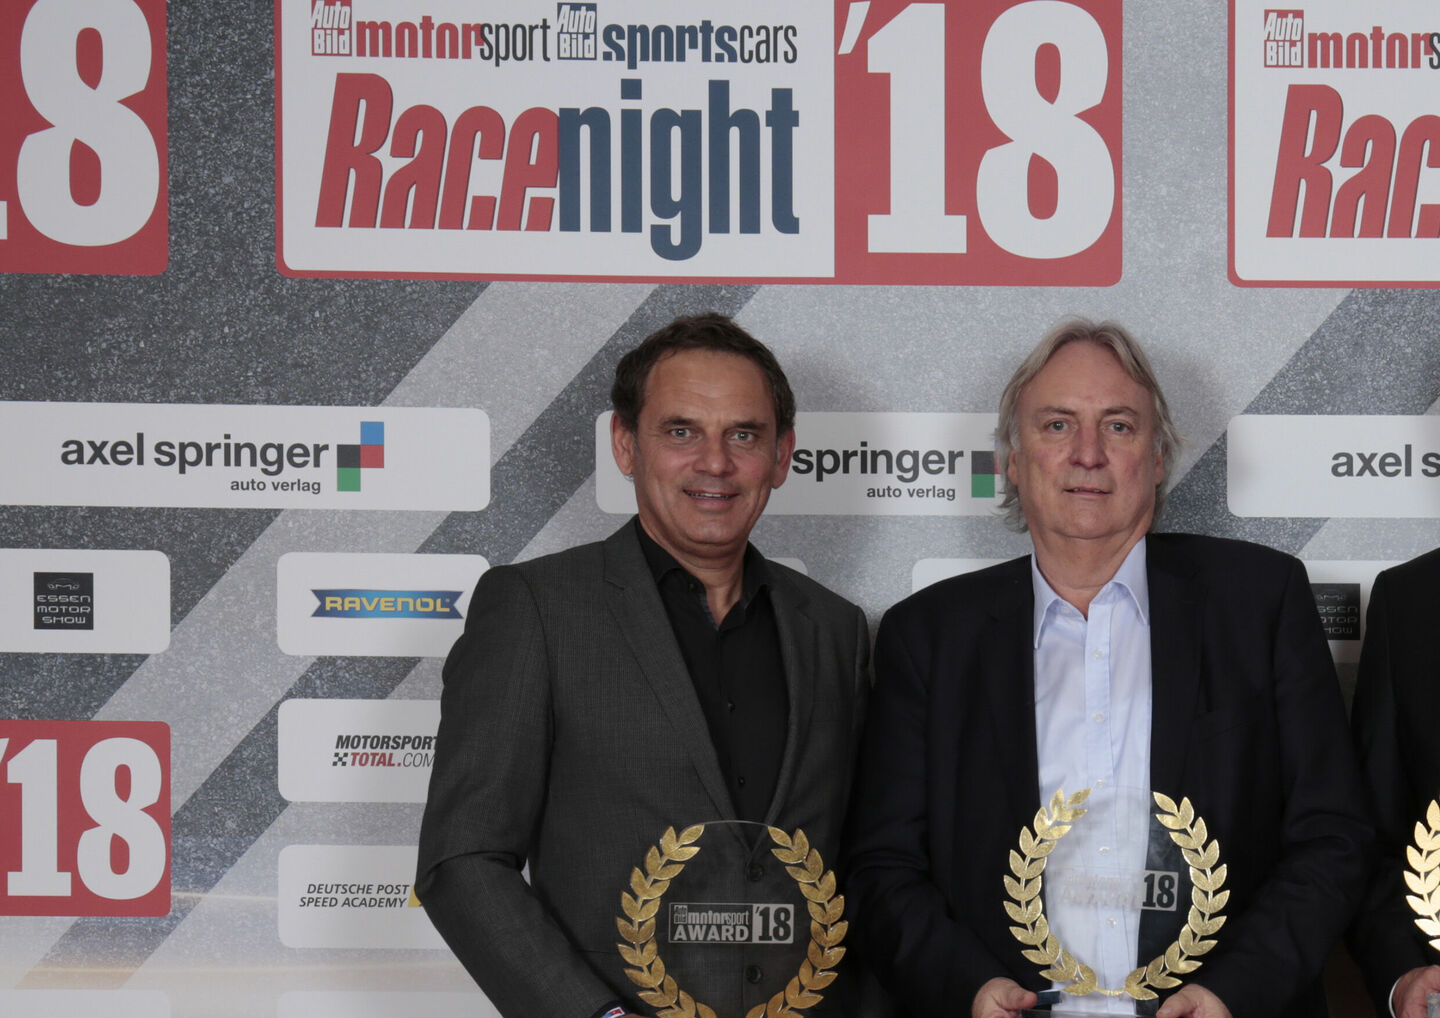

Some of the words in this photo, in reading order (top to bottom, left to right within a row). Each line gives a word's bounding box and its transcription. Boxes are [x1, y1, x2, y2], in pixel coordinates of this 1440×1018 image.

[311, 1, 351, 28] Auto
[557, 4, 596, 33] Auto
[1263, 12, 1303, 40] Auto
[313, 29, 349, 56] Bild
[356, 16, 551, 67] motorsport
[560, 33, 596, 60] Bild
[602, 19, 798, 70] sportscars
[1265, 40, 1302, 66] Bild
[0, 0, 160, 246] 8
[315, 72, 800, 261] Racenight
[60, 432, 144, 466] axel
[154, 433, 329, 476] springer
[792, 441, 964, 483] springer
[1331, 444, 1411, 478] axel
[230, 479, 267, 492] auto
[271, 478, 321, 495] verlag
[866, 485, 902, 498] auto
[907, 485, 957, 501] verlag
[325, 596, 451, 612] RAVENOL
[1317, 604, 1358, 613] SSEN
[42, 616, 86, 624] SHOW
[1324, 626, 1353, 634] HOW
[299, 897, 338, 908] SPEED
[341, 897, 407, 908] ACADEMY
[307, 884, 372, 895] DEUTSCHE
[376, 884, 410, 895] POST
[673, 925, 749, 941] AWARD
